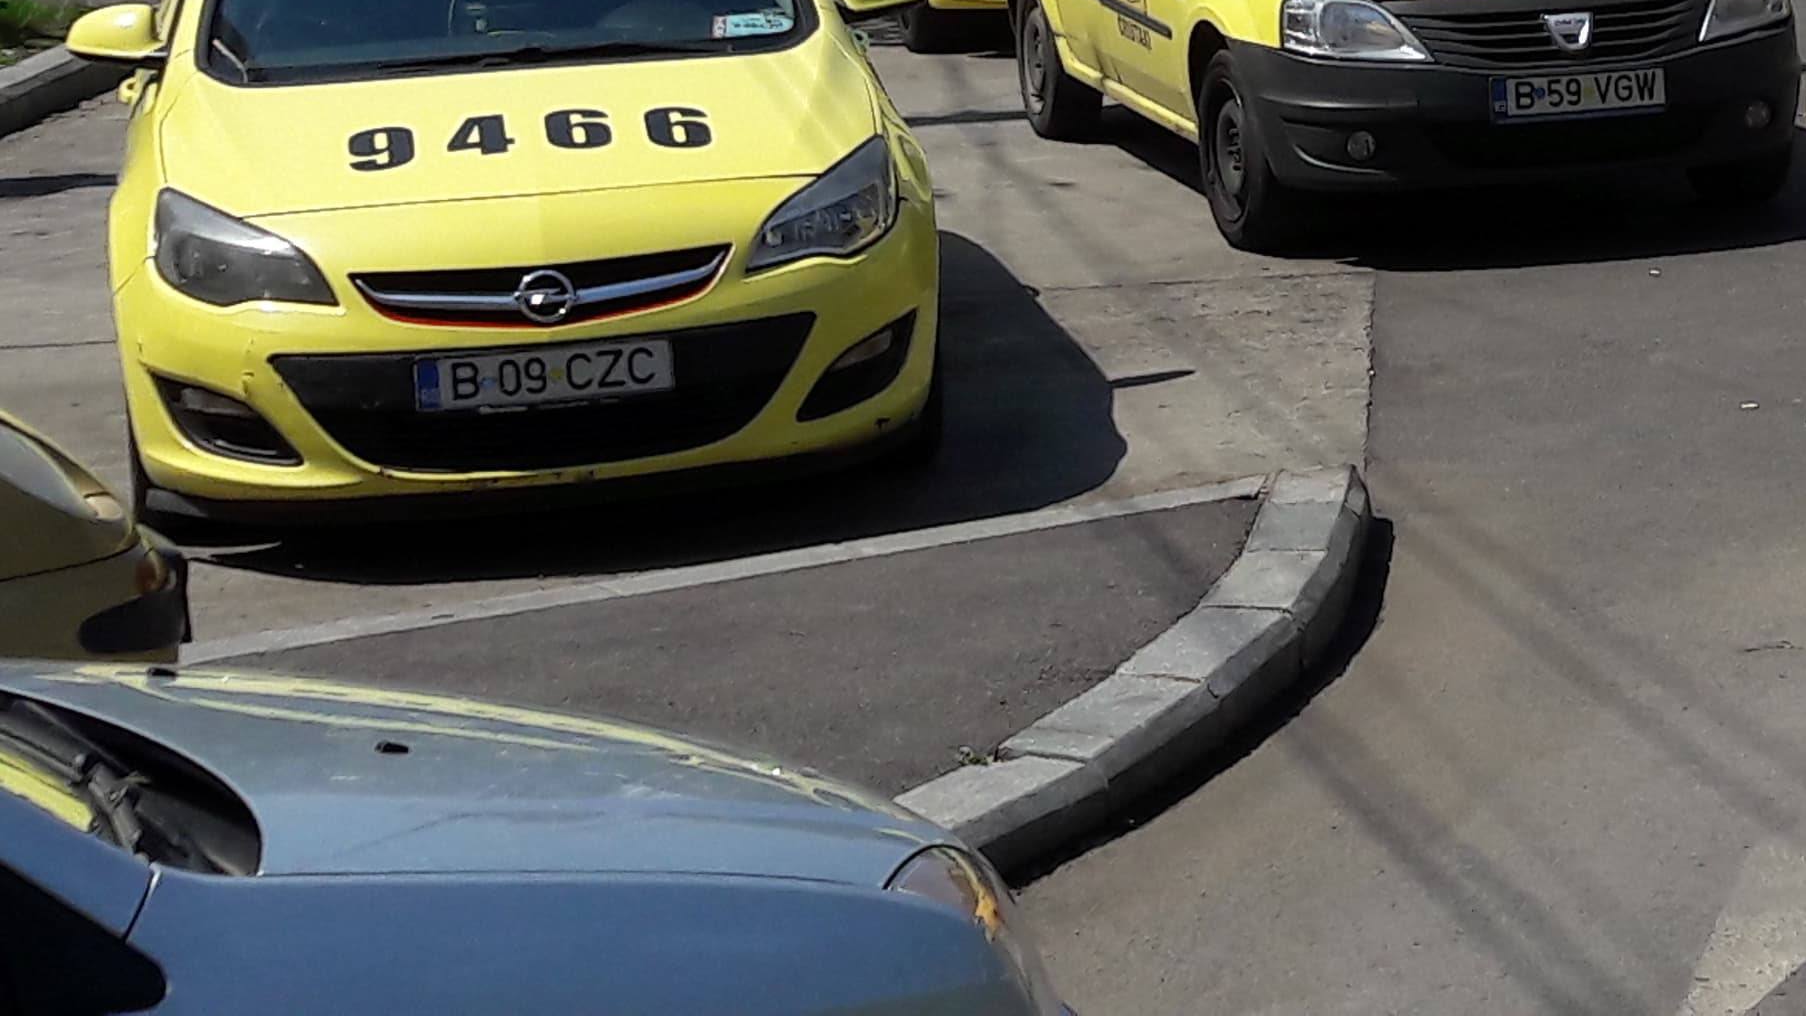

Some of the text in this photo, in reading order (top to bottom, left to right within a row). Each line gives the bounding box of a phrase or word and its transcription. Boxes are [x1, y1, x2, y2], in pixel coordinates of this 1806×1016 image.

[1515, 71, 1656, 110] B 59 VGW
[348, 106, 711, 172] 9466
[451, 347, 656, 401] B 09 CZC
